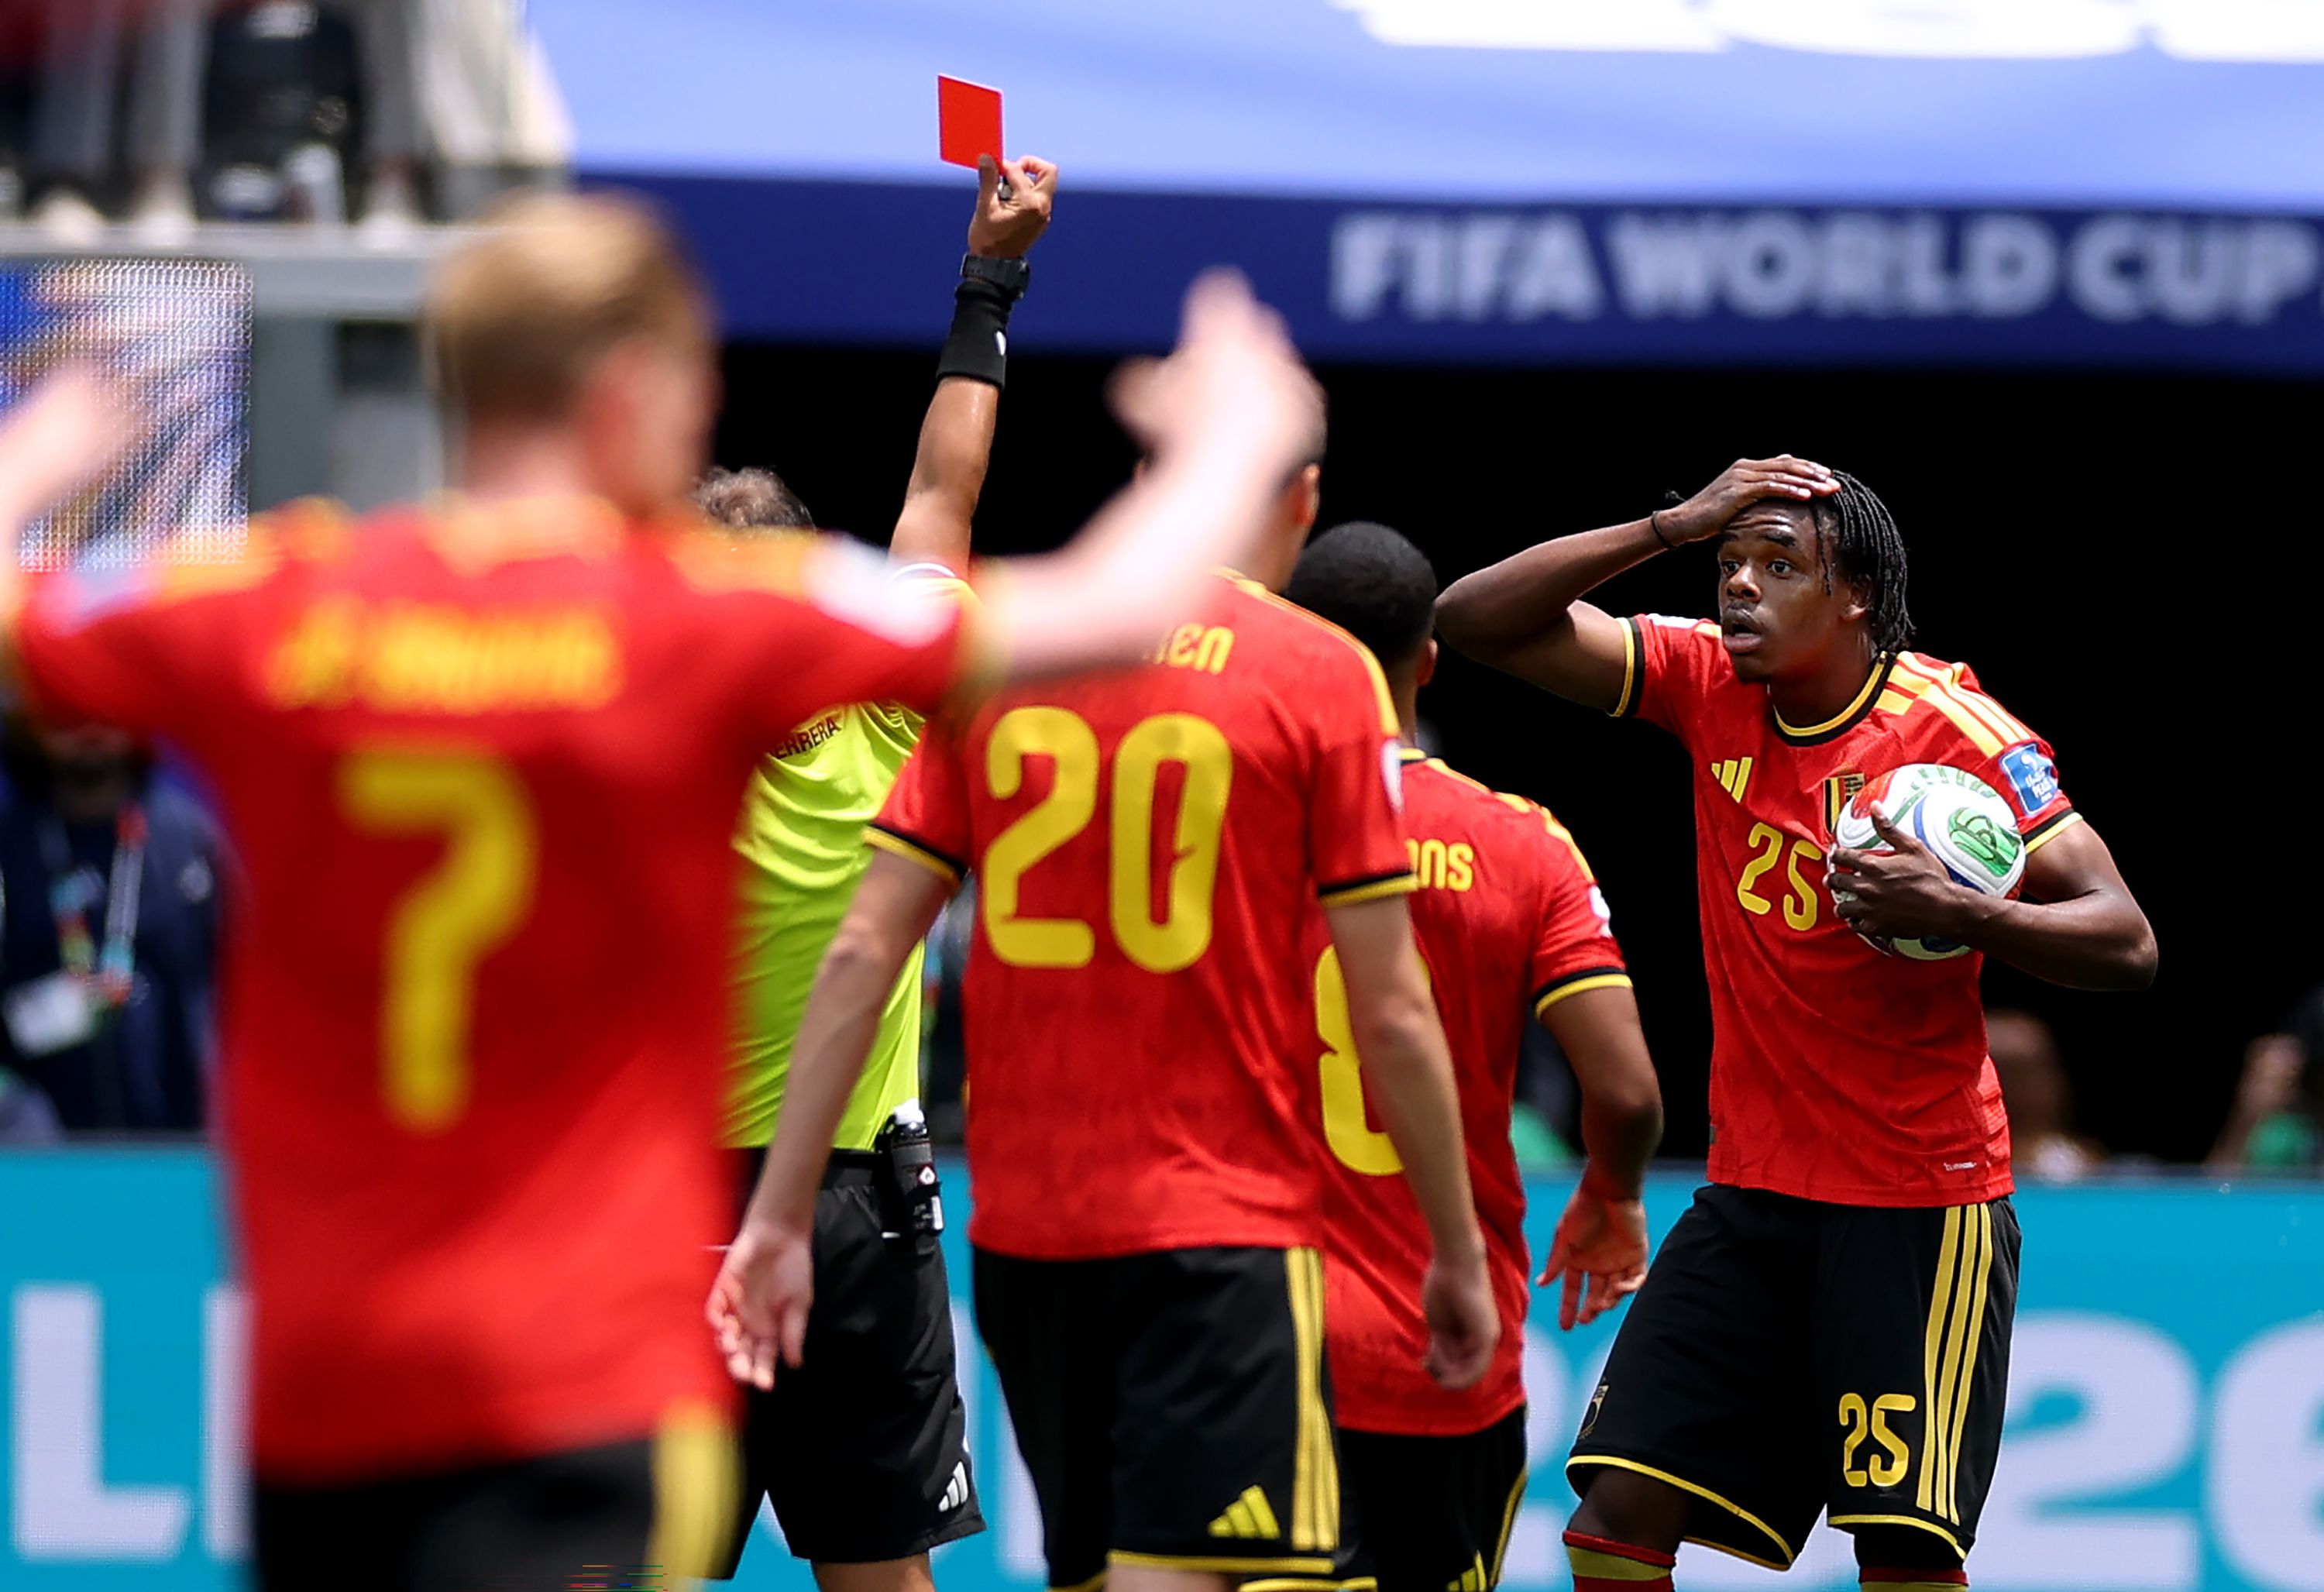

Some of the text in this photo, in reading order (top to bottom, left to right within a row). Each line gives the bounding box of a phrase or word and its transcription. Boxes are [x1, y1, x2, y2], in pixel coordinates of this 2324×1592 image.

[1332, 209, 2321, 324] FIFA WORLD CUP
[983, 705, 1233, 974] 20
[1738, 821, 1822, 931] 25
[335, 742, 537, 1131] 7
[1839, 1392, 1917, 1487] 25
